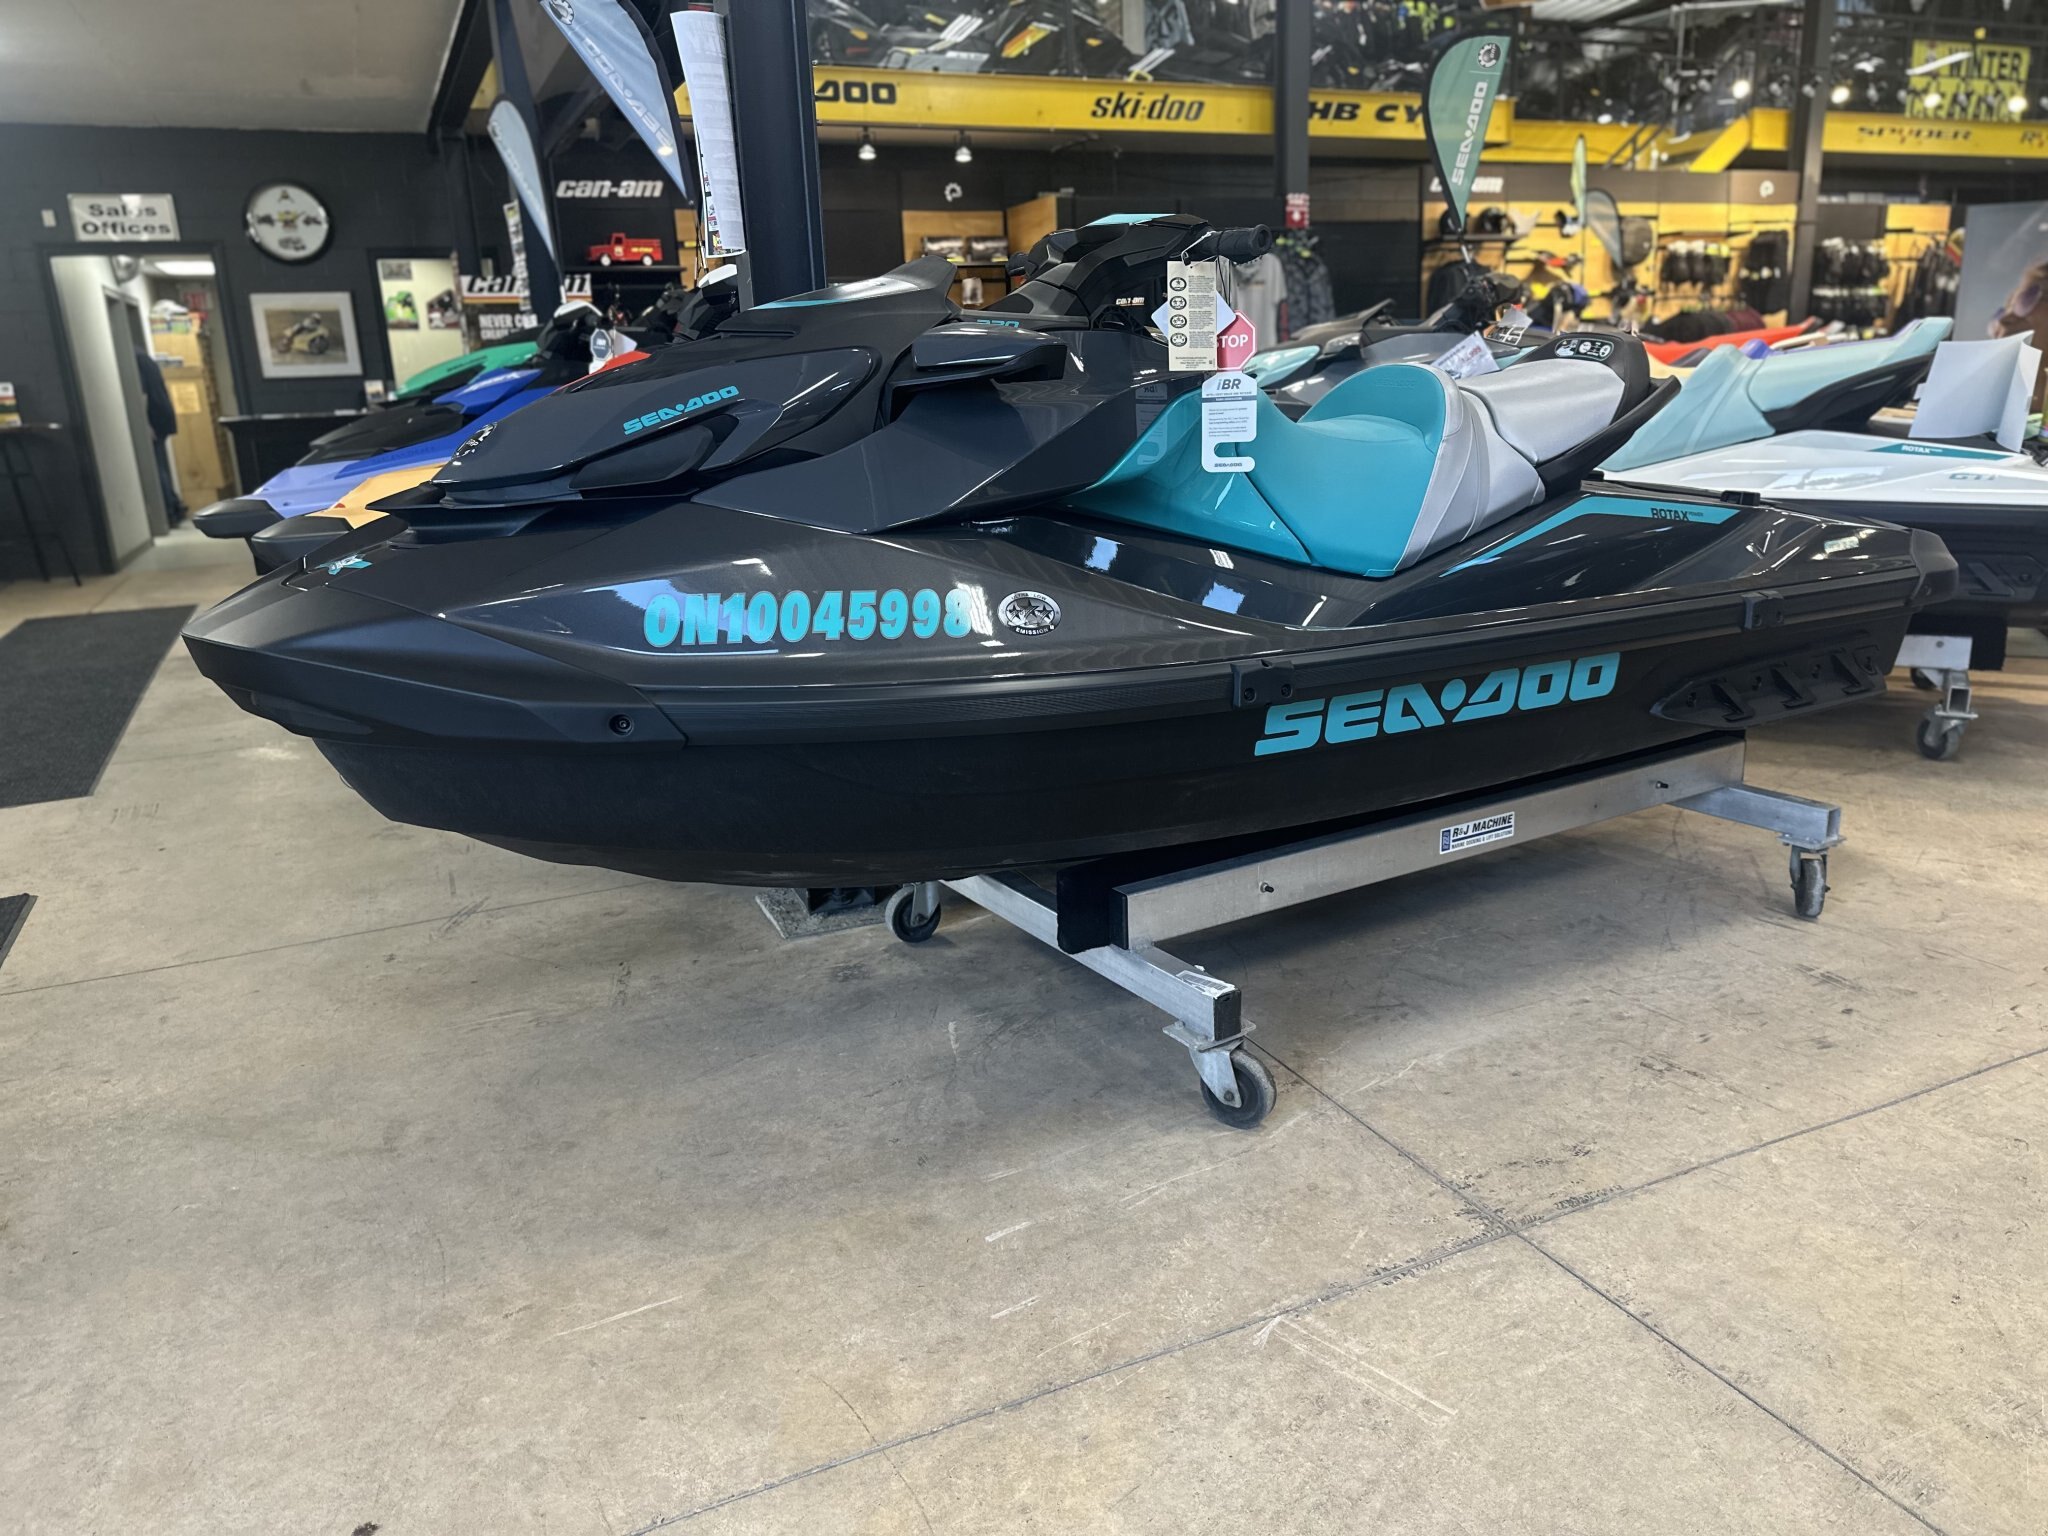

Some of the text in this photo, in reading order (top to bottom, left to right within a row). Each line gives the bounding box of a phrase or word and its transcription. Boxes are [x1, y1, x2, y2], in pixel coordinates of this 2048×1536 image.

[556, 180, 663, 198] can-am
[1217, 333, 1249, 349] TOP
[1217, 379, 1241, 390] iBR
[1901, 444, 1931, 454] ROTAX
[1650, 507, 1690, 521] ROTAX
[643, 588, 973, 647] ON10045998
[1471, 814, 1514, 833] MACHINE
